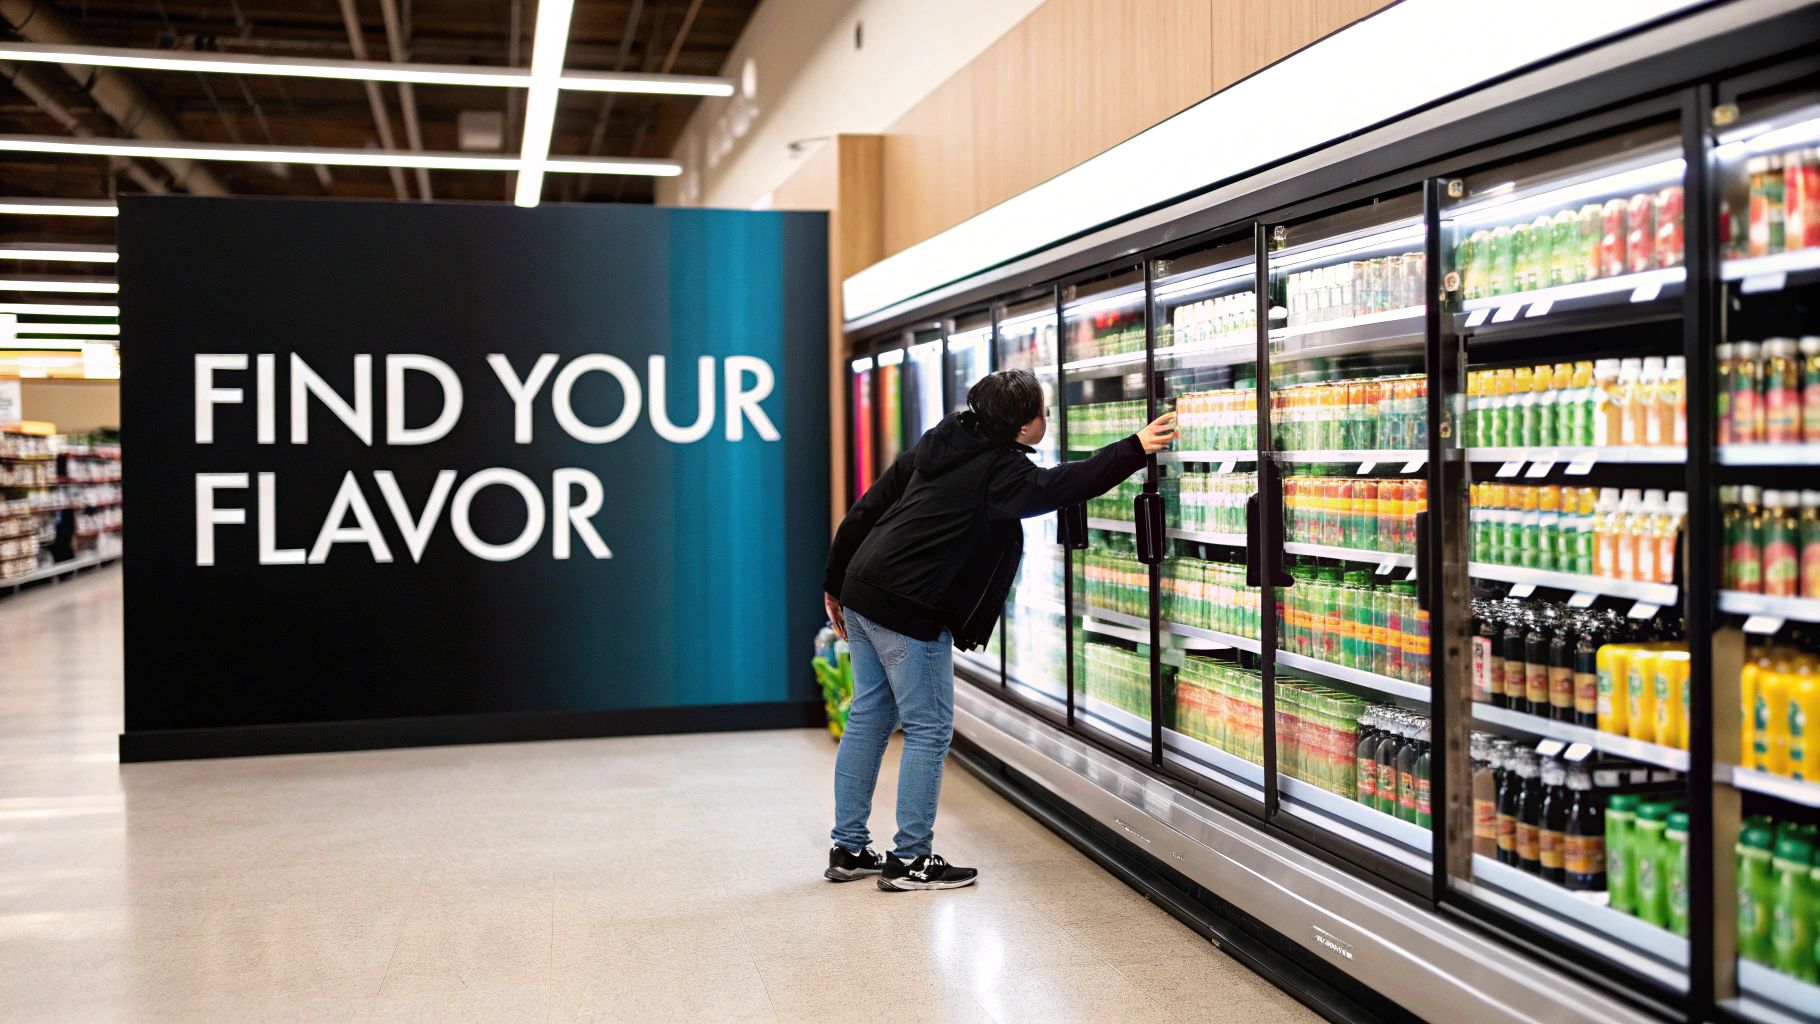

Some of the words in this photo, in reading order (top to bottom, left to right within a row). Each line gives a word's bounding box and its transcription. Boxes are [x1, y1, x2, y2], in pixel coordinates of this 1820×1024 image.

[194, 352, 463, 446] FIND
[487, 353, 781, 444] YOUR
[195, 467, 612, 566] FLAVOR
